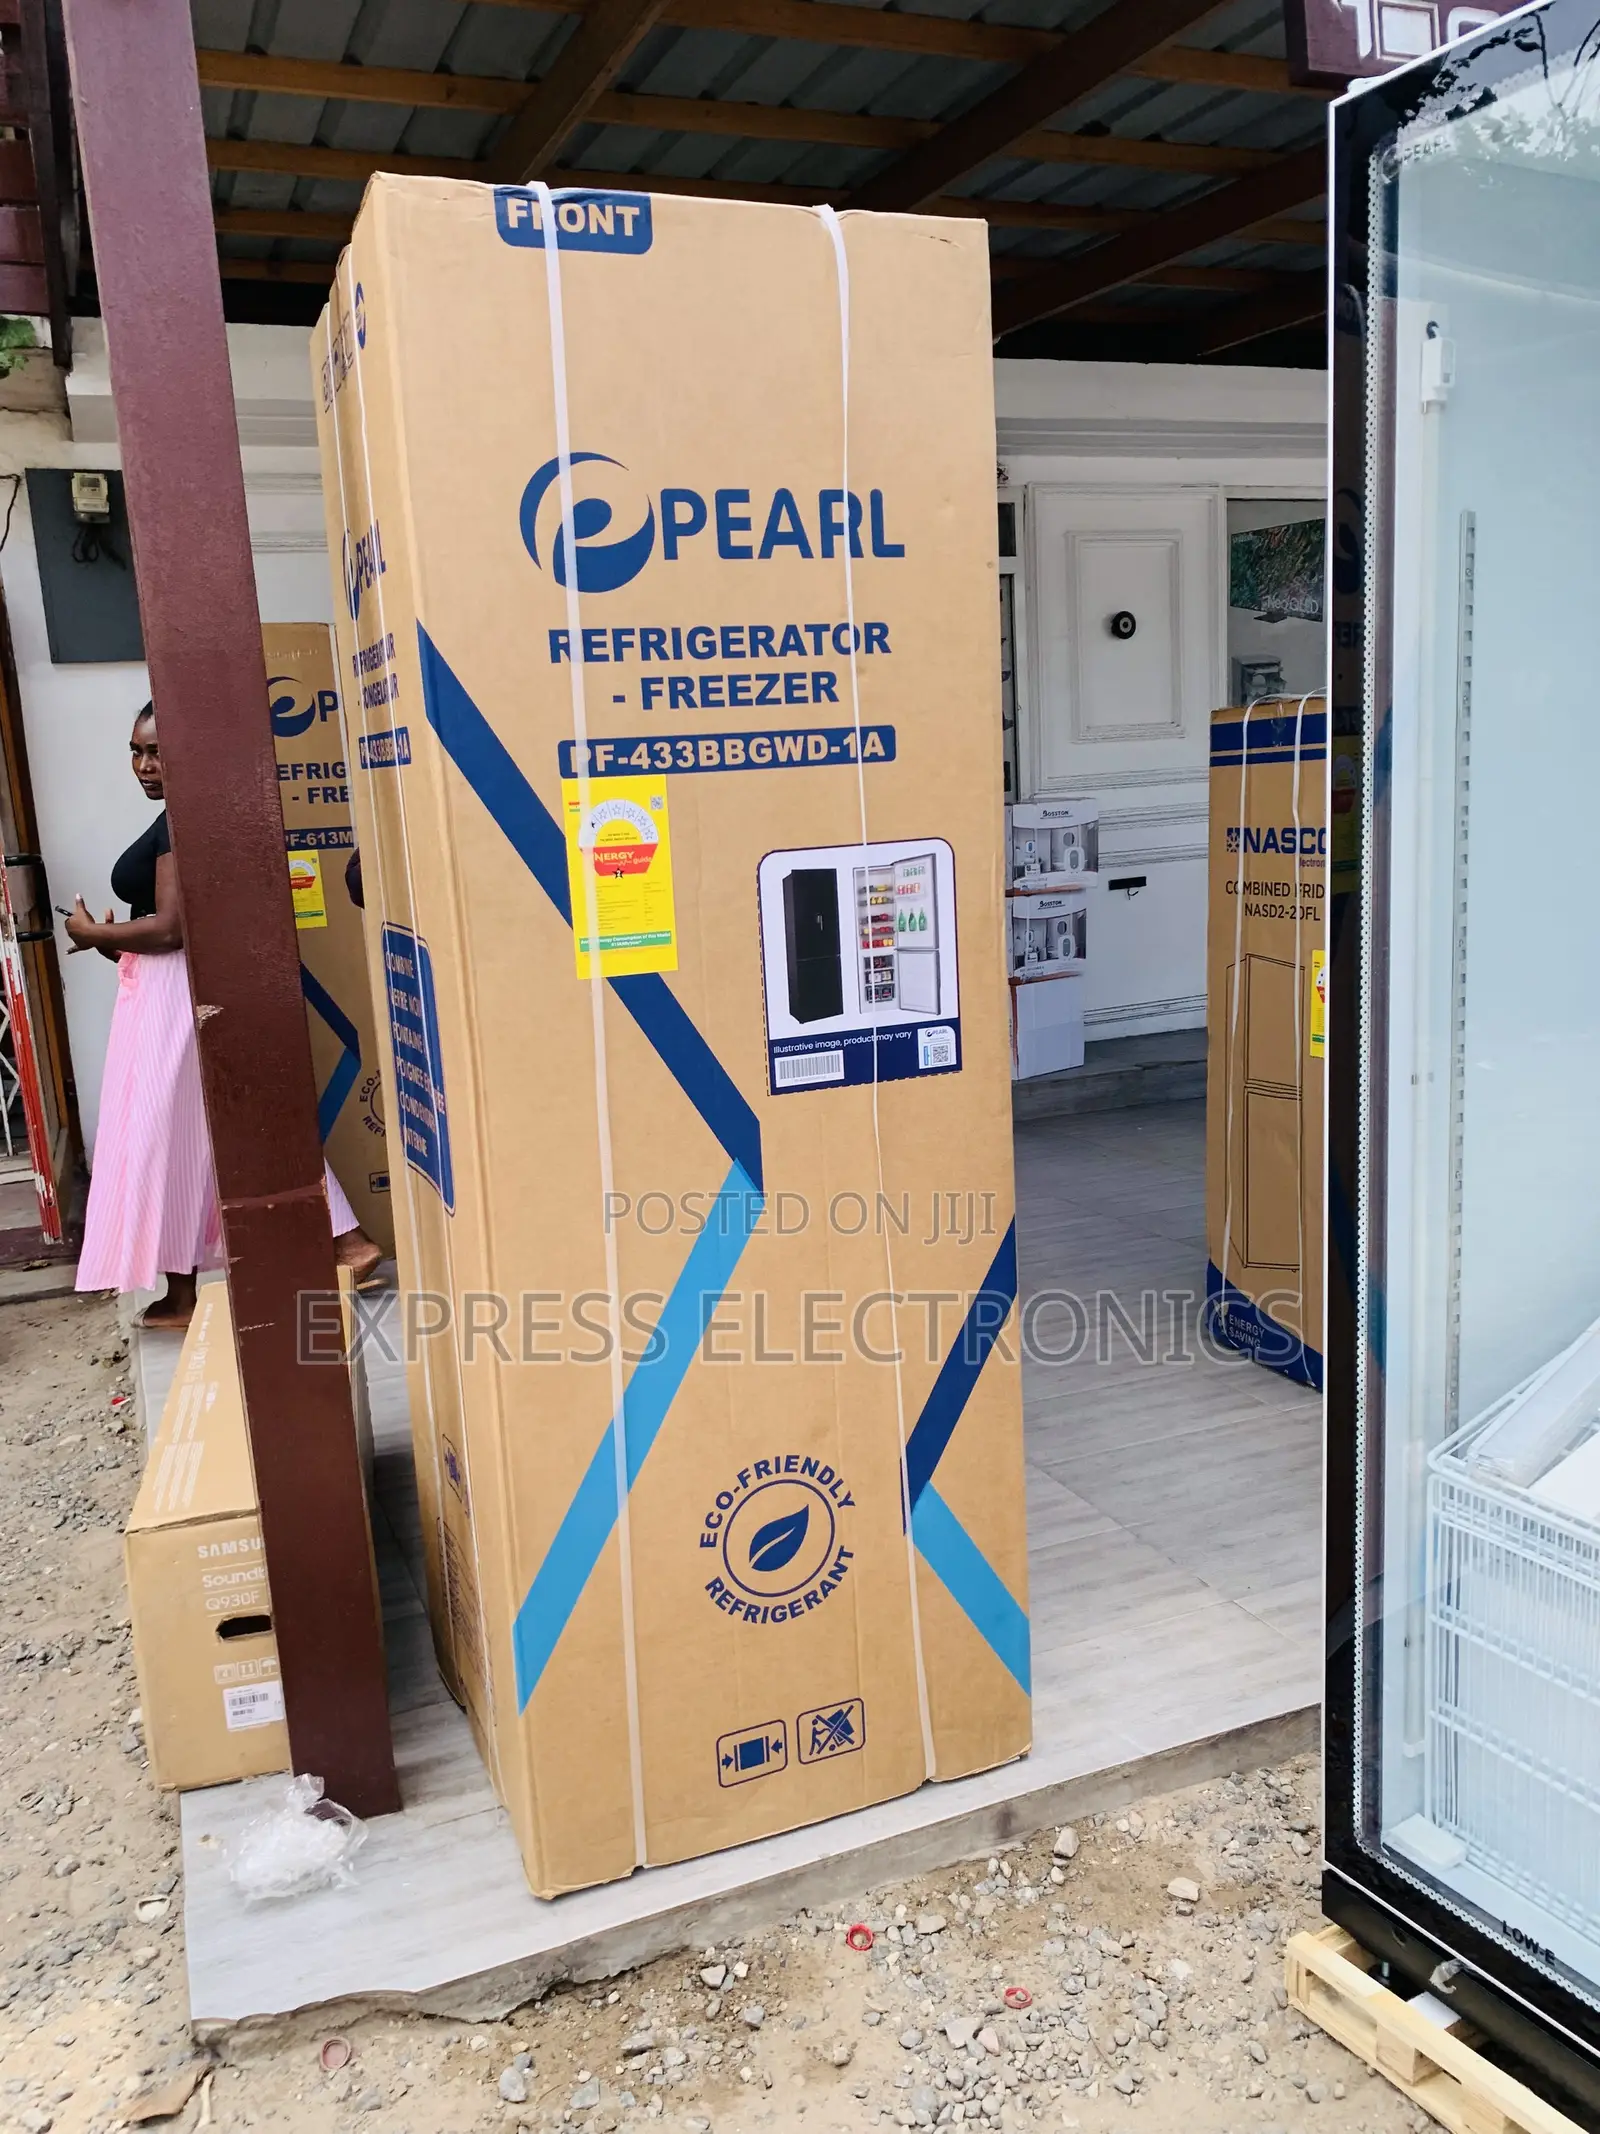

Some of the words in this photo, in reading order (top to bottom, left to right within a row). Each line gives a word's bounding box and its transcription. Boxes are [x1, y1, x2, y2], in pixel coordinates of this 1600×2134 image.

[661, 486, 905, 560] PEARL
[548, 620, 892, 664] REFRIGERATOR
[640, 670, 840, 711] FREEZER
[593, 850, 635, 863] NERGY
[773, 1042, 814, 1054] Illustrative
[814, 1039, 843, 1051] image,
[843, 1034, 875, 1047] product
[876, 1033, 894, 1044] may
[895, 1030, 913, 1040] vary
[699, 1454, 856, 1549] ECO-FRIENDLY
[704, 1545, 855, 1625] REFRIGERANT
[1502, 1919, 1556, 1966] LOW-E
